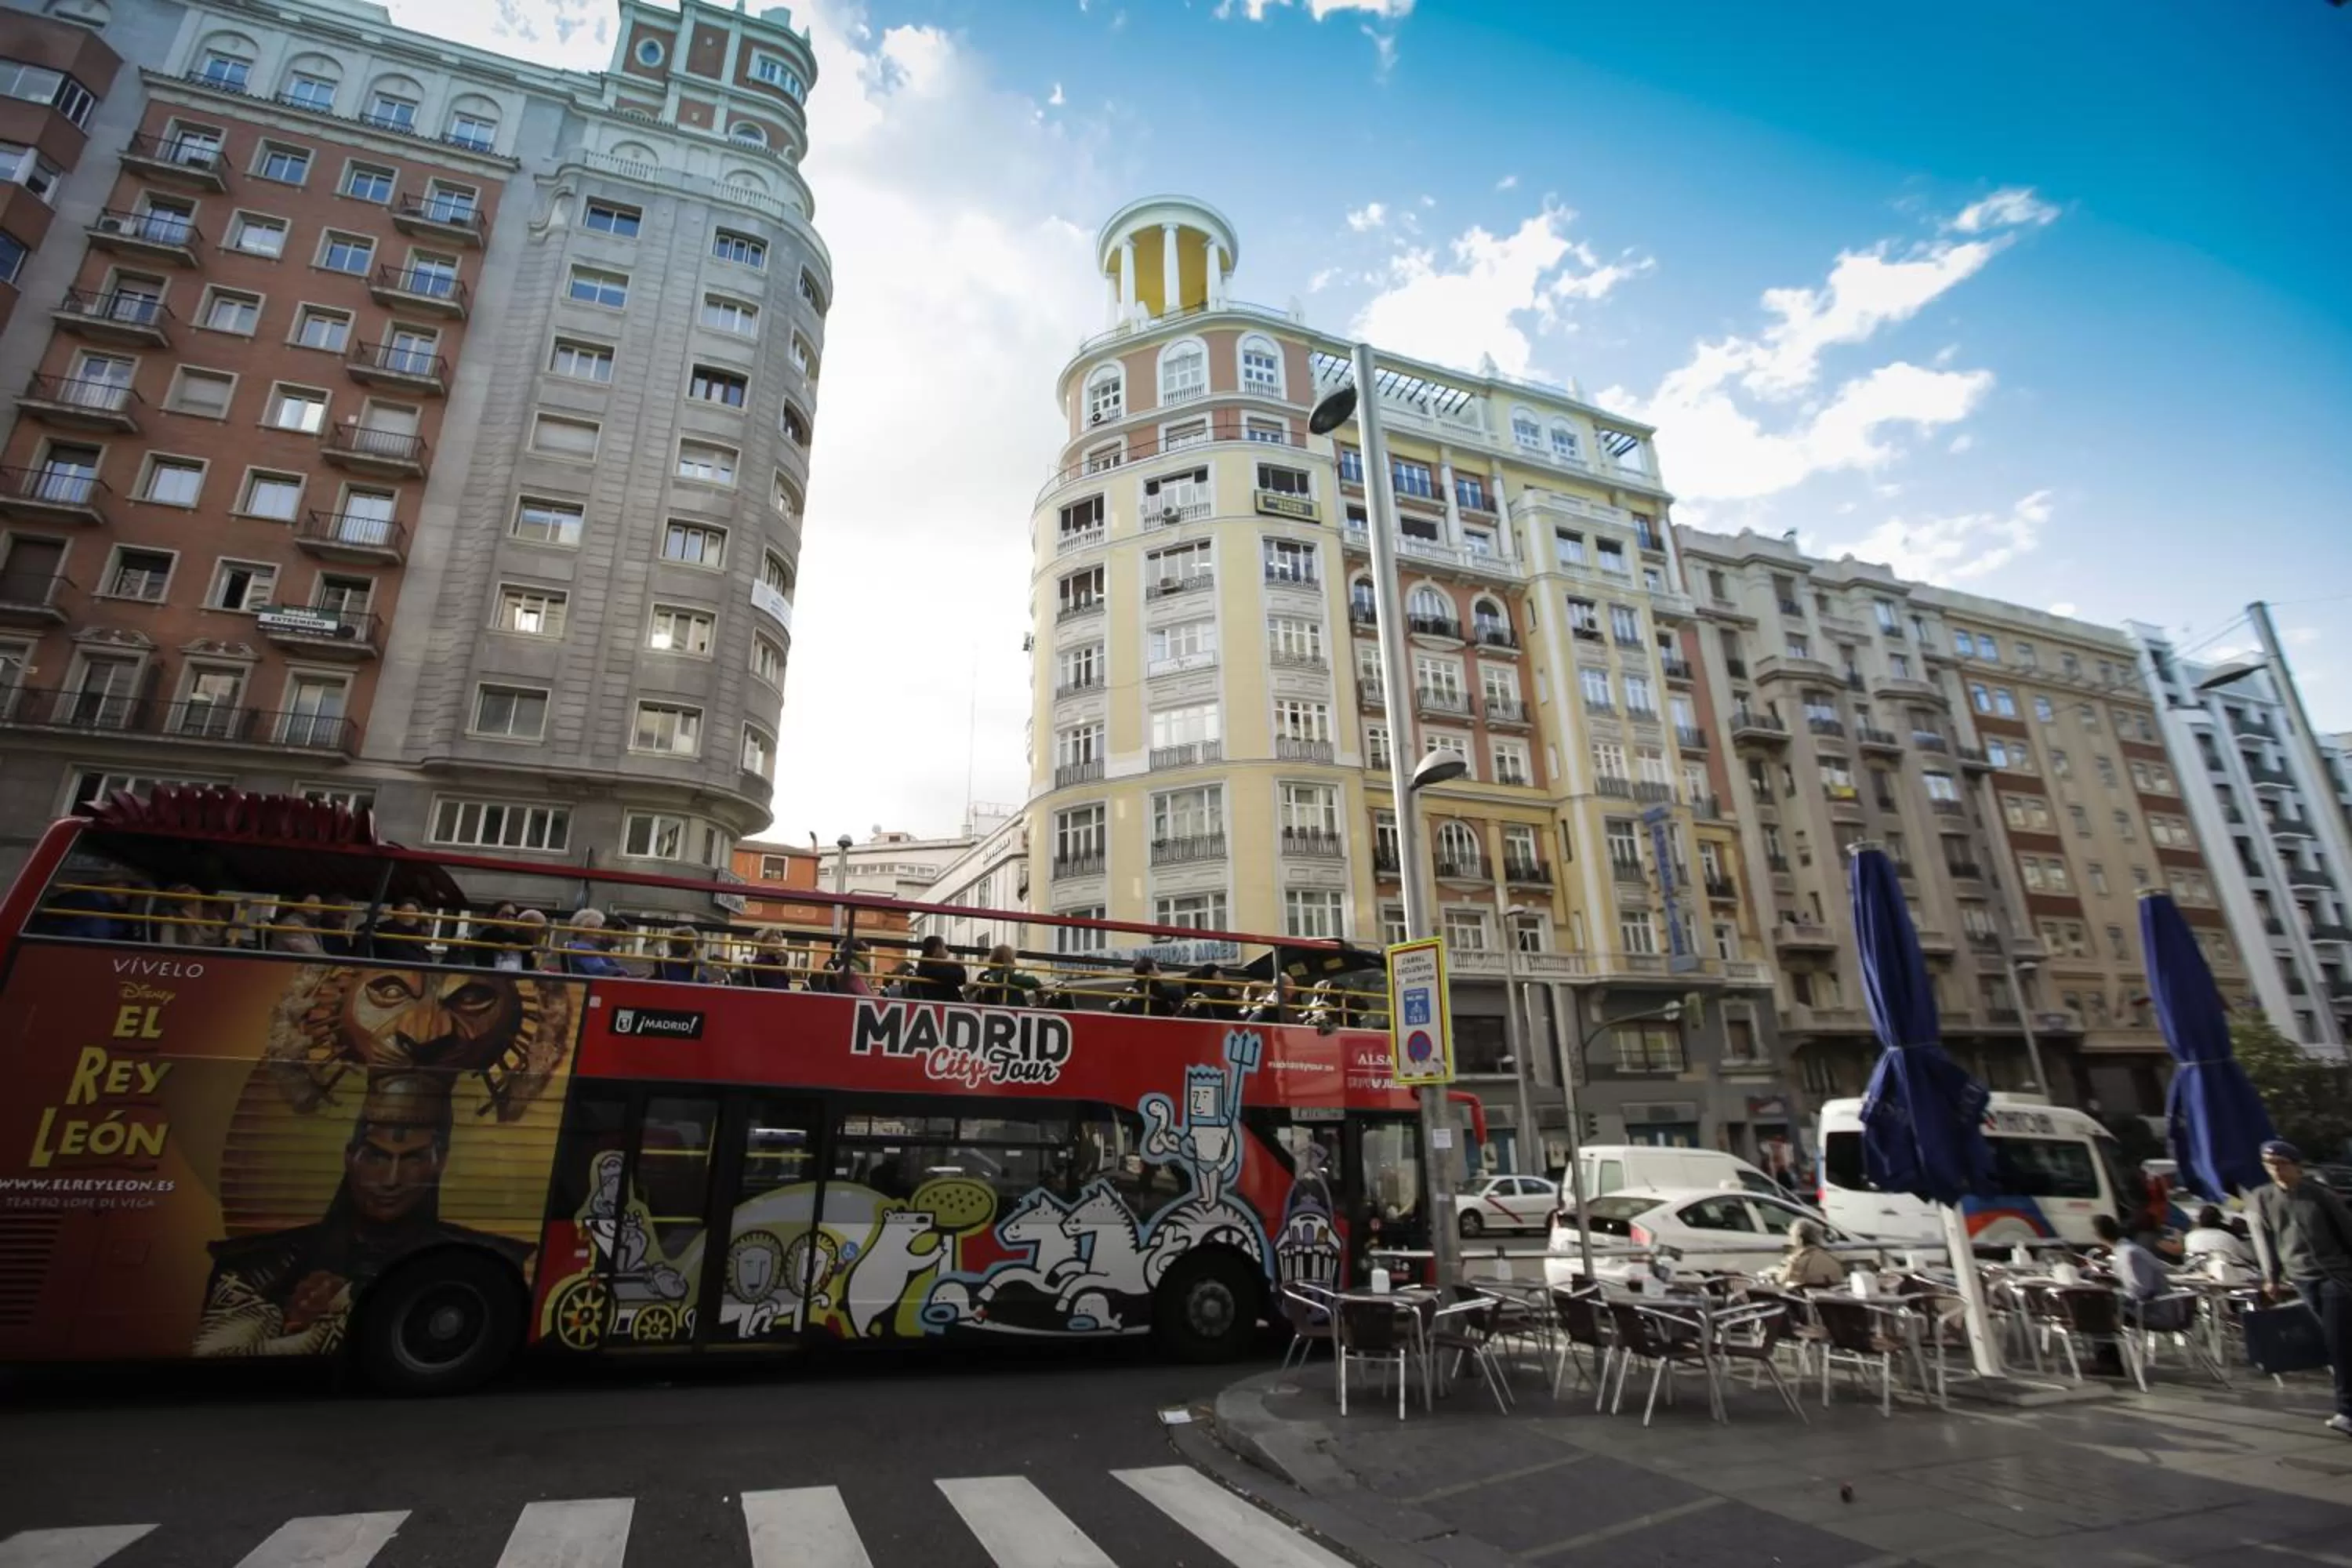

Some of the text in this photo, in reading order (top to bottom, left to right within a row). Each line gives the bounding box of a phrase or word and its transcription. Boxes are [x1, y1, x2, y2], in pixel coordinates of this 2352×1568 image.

[1194, 941, 1239, 962] AIRES
[113, 956, 205, 978] VÍVELO
[119, 981, 176, 1004] Disney
[113, 1005, 164, 1039] EL
[636, 1016, 699, 1034] ¡MADRID!
[853, 1001, 1071, 1063] MADRID
[927, 1047, 1057, 1084] City Tour
[1357, 1053, 1393, 1066] ALSA
